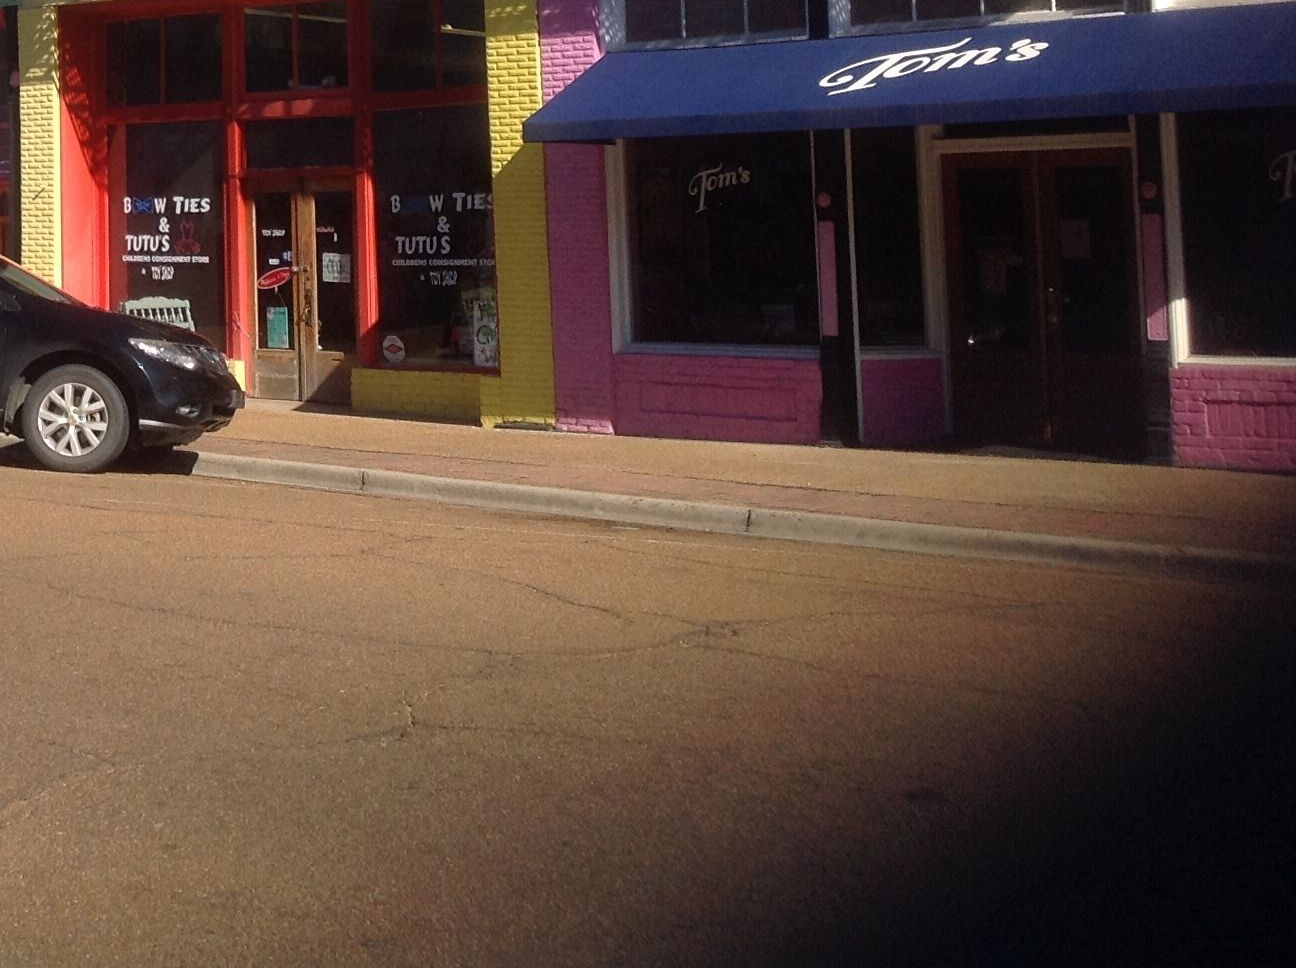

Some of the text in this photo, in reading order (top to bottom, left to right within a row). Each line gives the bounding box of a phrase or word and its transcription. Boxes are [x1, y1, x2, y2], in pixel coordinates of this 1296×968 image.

[818, 37, 1050, 96] Tom's
[688, 160, 751, 213] Tom's
[173, 196, 211, 214] TIES
[391, 194, 444, 213] BW
[159, 217, 170, 233] &
[437, 216, 451, 233] &
[125, 234, 170, 252] TUTU'S
[395, 235, 451, 254] TUTUS
